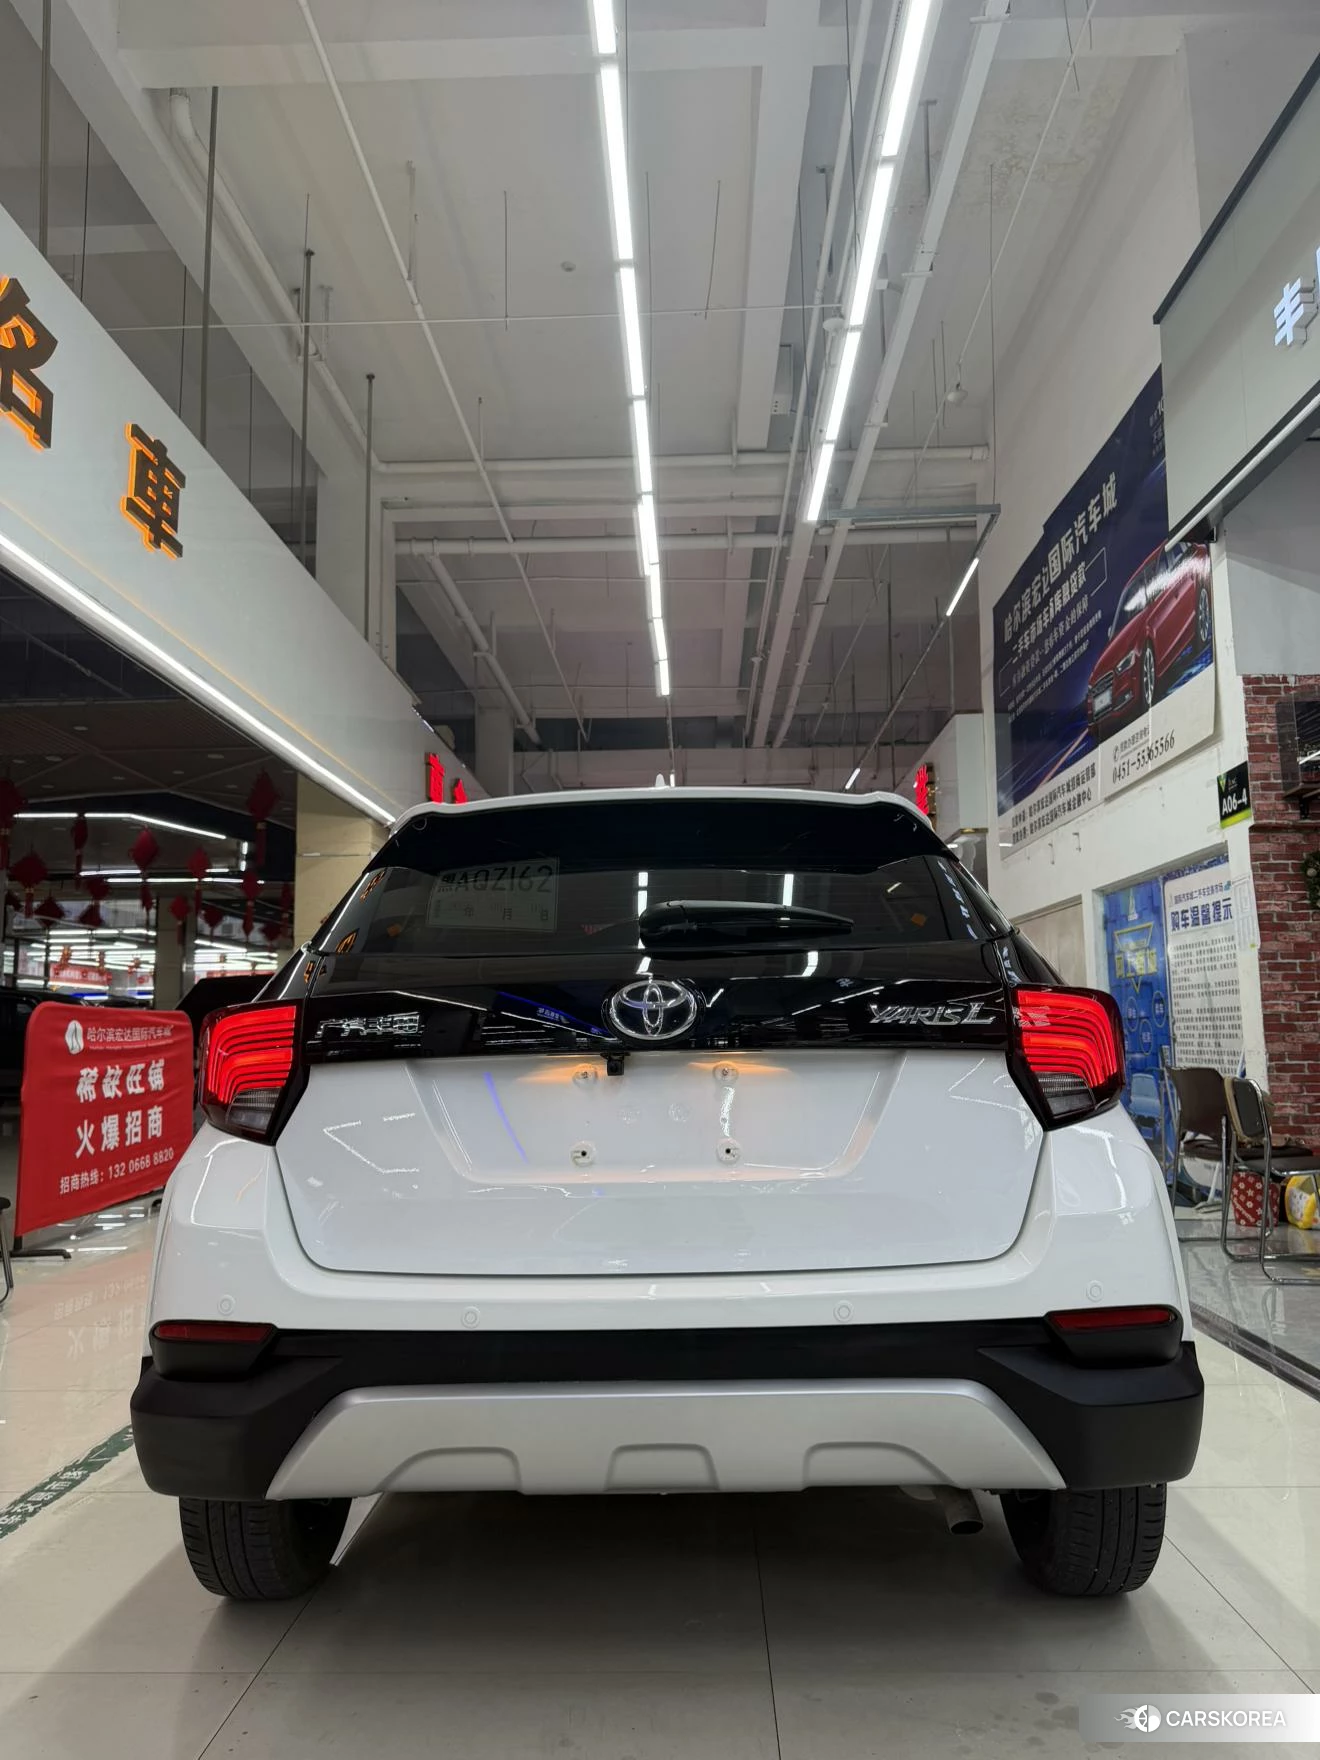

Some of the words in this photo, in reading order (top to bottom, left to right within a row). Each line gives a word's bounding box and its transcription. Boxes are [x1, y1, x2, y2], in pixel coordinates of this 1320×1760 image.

[1112, 728, 1175, 784] 0451-55365566
[1222, 788, 1247, 816] A06-4
[1171, 897, 1232, 932] 购车温馨提示
[76, 1059, 165, 1103] 稀缺旺铺
[75, 1106, 163, 1158] 火爆招商
[108, 1164, 126, 1180] 132
[128, 1156, 151, 1173] 0668
[153, 1147, 174, 1165] 8820
[0, 1466, 88, 1529] 车交易市场
